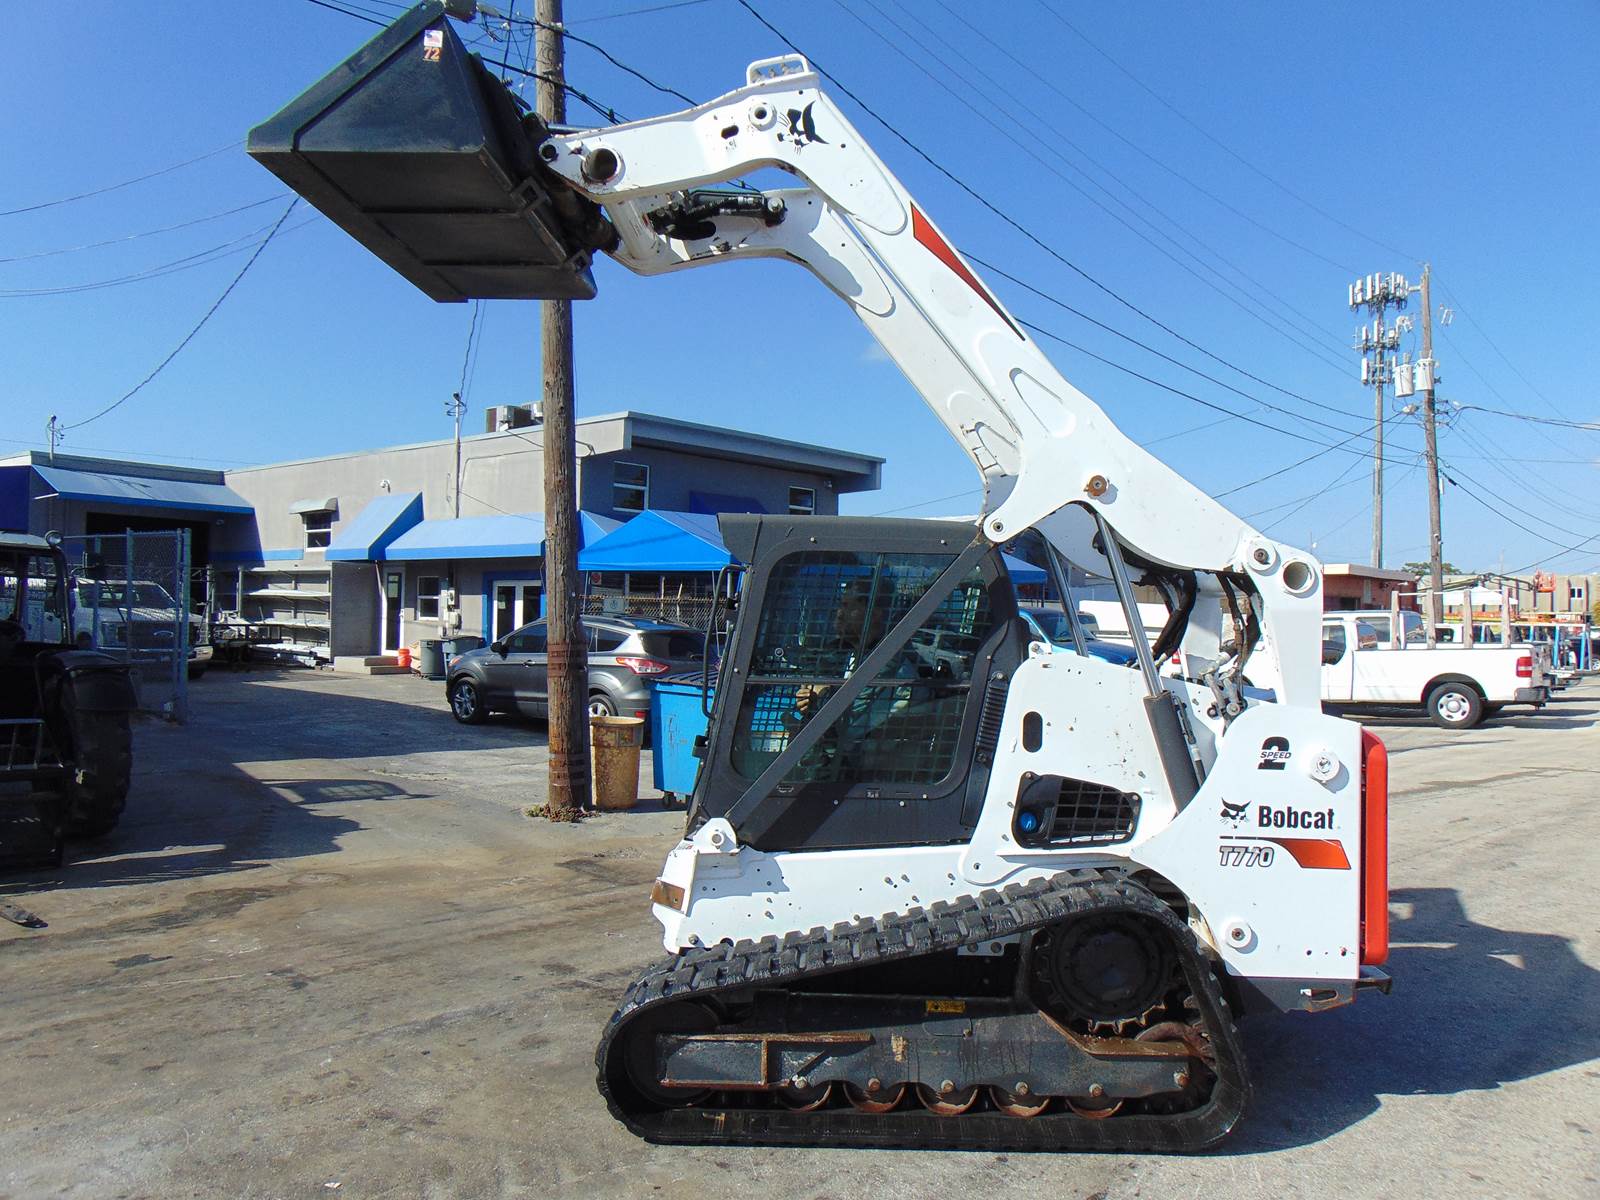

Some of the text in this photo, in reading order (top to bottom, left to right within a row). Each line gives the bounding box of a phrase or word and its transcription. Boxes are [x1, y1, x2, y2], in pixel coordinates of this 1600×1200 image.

[424, 47, 440, 60] 72
[1257, 736, 1290, 770] 2
[1260, 751, 1292, 759] SPEED
[1258, 805, 1335, 830] Bobcat
[1219, 845, 1275, 868] T770
